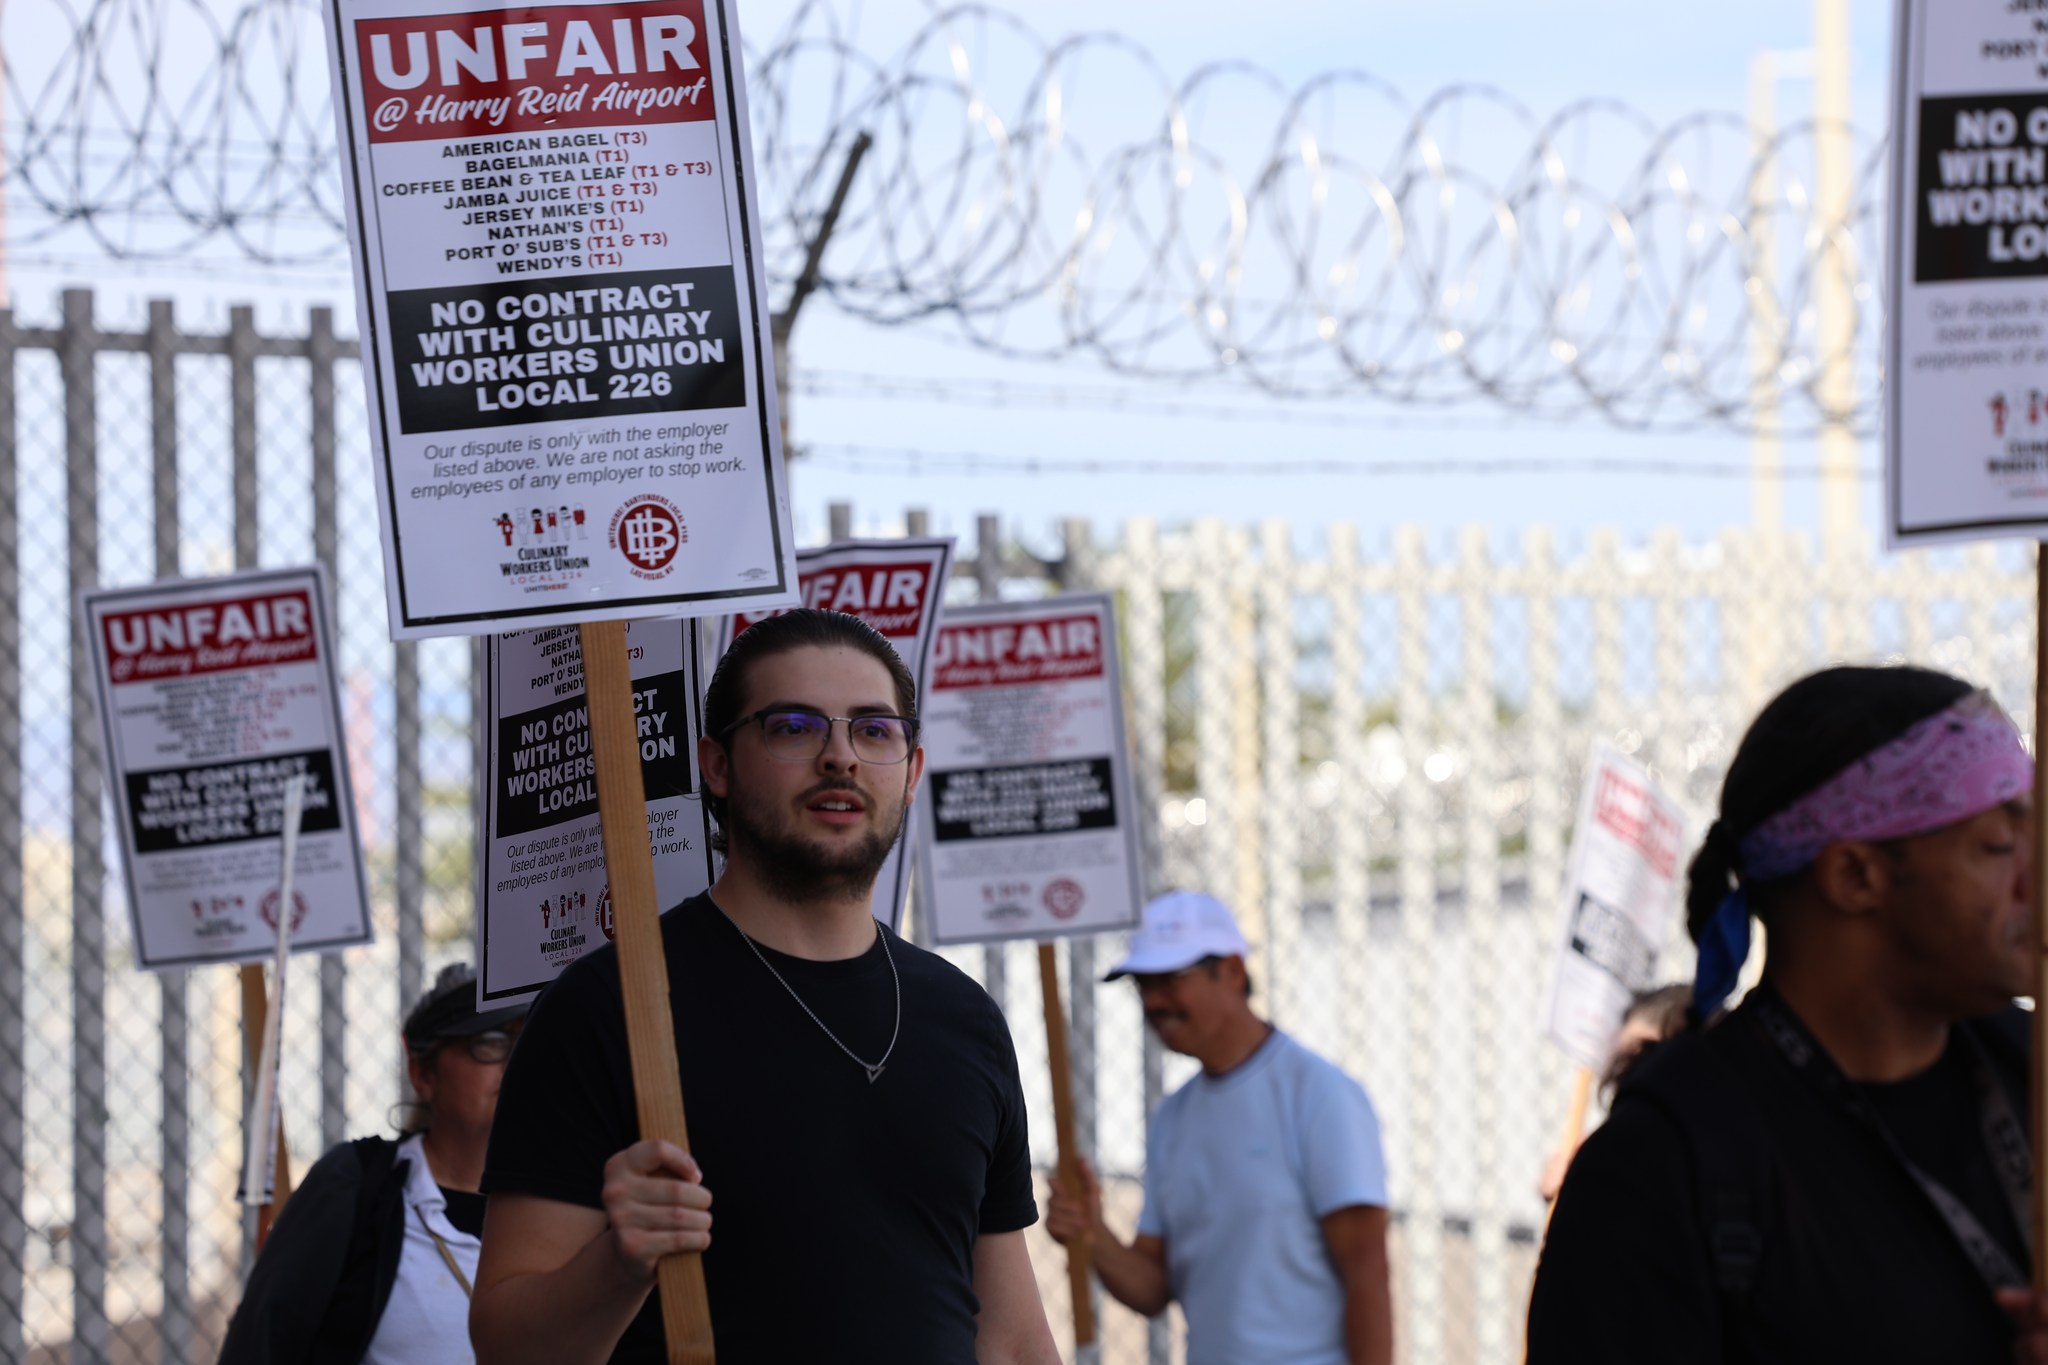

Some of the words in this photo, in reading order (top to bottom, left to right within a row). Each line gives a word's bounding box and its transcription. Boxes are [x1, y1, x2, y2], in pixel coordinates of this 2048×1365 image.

[370, 15, 701, 90] UNFAIR
[373, 96, 409, 132] @
[415, 94, 511, 126] Harry
[517, 83, 589, 116] Reid
[591, 76, 706, 116] Airport
[1954, 108, 2018, 147] NO
[442, 138, 541, 158] AMERICAN
[548, 134, 609, 149] BAGEL
[614, 131, 647, 147] (T3)
[466, 152, 590, 173] BAGELMANIA
[596, 149, 629, 164] (T1)
[1938, 146, 2046, 186] WITH
[383, 180, 455, 196] COFFEE
[461, 174, 512, 191] BEAN
[520, 173, 534, 185] &
[540, 170, 575, 183] TEA
[582, 167, 626, 181] LEAF
[632, 165, 659, 180] (T1
[665, 164, 679, 176] &
[684, 161, 712, 176] T3)
[444, 192, 509, 210] JAMBA
[516, 187, 571, 203] JUICE
[577, 185, 605, 200] (T1
[612, 184, 624, 196] &
[630, 182, 658, 196] T3)
[1927, 184, 2048, 227] WORK
[462, 207, 534, 225] JERSEY
[542, 202, 605, 218] MIKE'S
[610, 199, 644, 215] (T1)
[488, 220, 583, 240] NATHAN'S
[589, 218, 624, 233] (T1)
[446, 245, 495, 261] PORT
[502, 243, 520, 256] O'
[526, 238, 581, 254] SUB'S
[587, 236, 615, 251] (T1
[622, 235, 635, 247] &
[640, 232, 668, 246] T3)
[497, 255, 582, 273] WENDY'S
[588, 252, 623, 268] (T1)
[430, 300, 486, 327] NO
[496, 282, 694, 321] CONTRACT
[417, 325, 516, 357] WITH
[527, 310, 711, 348] CULINARY
[411, 348, 599, 387] WORKERS
[609, 339, 725, 370] UNION
[476, 377, 599, 412] LOCAL
[608, 371, 673, 400] 226
[424, 445, 456, 460] Our
[461, 439, 523, 458] dispute
[528, 436, 542, 451] is
[547, 432, 584, 450] only
[588, 428, 621, 445] with
[626, 427, 652, 442] the
[657, 422, 729, 441] employer
[433, 460, 478, 478] listed
[483, 458, 540, 474] above.
[546, 452, 575, 467] We
[580, 451, 607, 465] are
[612, 447, 639, 461] not
[644, 443, 695, 460] asking
[699, 441, 723, 455] the
[411, 478, 504, 500] employees
[508, 474, 526, 490] of
[530, 474, 561, 490] any
[566, 467, 644, 486] employer
[649, 464, 664, 478] to
[668, 462, 701, 478] stop
[705, 457, 746, 473] work.
[500, 561, 551, 576] WORKERS
[554, 557, 589, 571] UNION
[518, 545, 569, 561] CULINARY
[510, 575, 554, 585] LOCAL
[561, 571, 582, 580] 226
[108, 597, 308, 656] UNFAIR
[533, 627, 562, 645] JAMBA
[540, 638, 573, 658] JERSEY
[552, 649, 582, 668] NATHA
[531, 673, 555, 689] PORT
[557, 669, 565, 681] O'
[568, 663, 584, 677] SUB
[554, 677, 585, 696] WENDY
[521, 720, 547, 745] NO
[513, 737, 560, 772] WITH
[147, 773, 182, 790] NO
[507, 756, 595, 798] WORKERS
[539, 780, 597, 814] LOCAL
[507, 844, 525, 858] Our
[527, 836, 560, 855] dispute
[562, 832, 568, 845] is
[570, 826, 588, 842] only
[589, 822, 602, 836] wit
[510, 857, 536, 873] listed
[538, 852, 567, 868] above.
[570, 846, 584, 860] We
[585, 843, 597, 855] are
[656, 825, 675, 838] the
[497, 870, 548, 892] employees
[550, 867, 560, 880] of
[561, 864, 576, 878] any
[578, 854, 607, 873] employ
[661, 837, 693, 853] work.
[540, 939, 568, 954] WORKERS
[569, 934, 586, 947] UNION
[551, 925, 577, 940] CULINARY
[544, 951, 569, 961] LOCAL
[571, 947, 582, 955] 226
